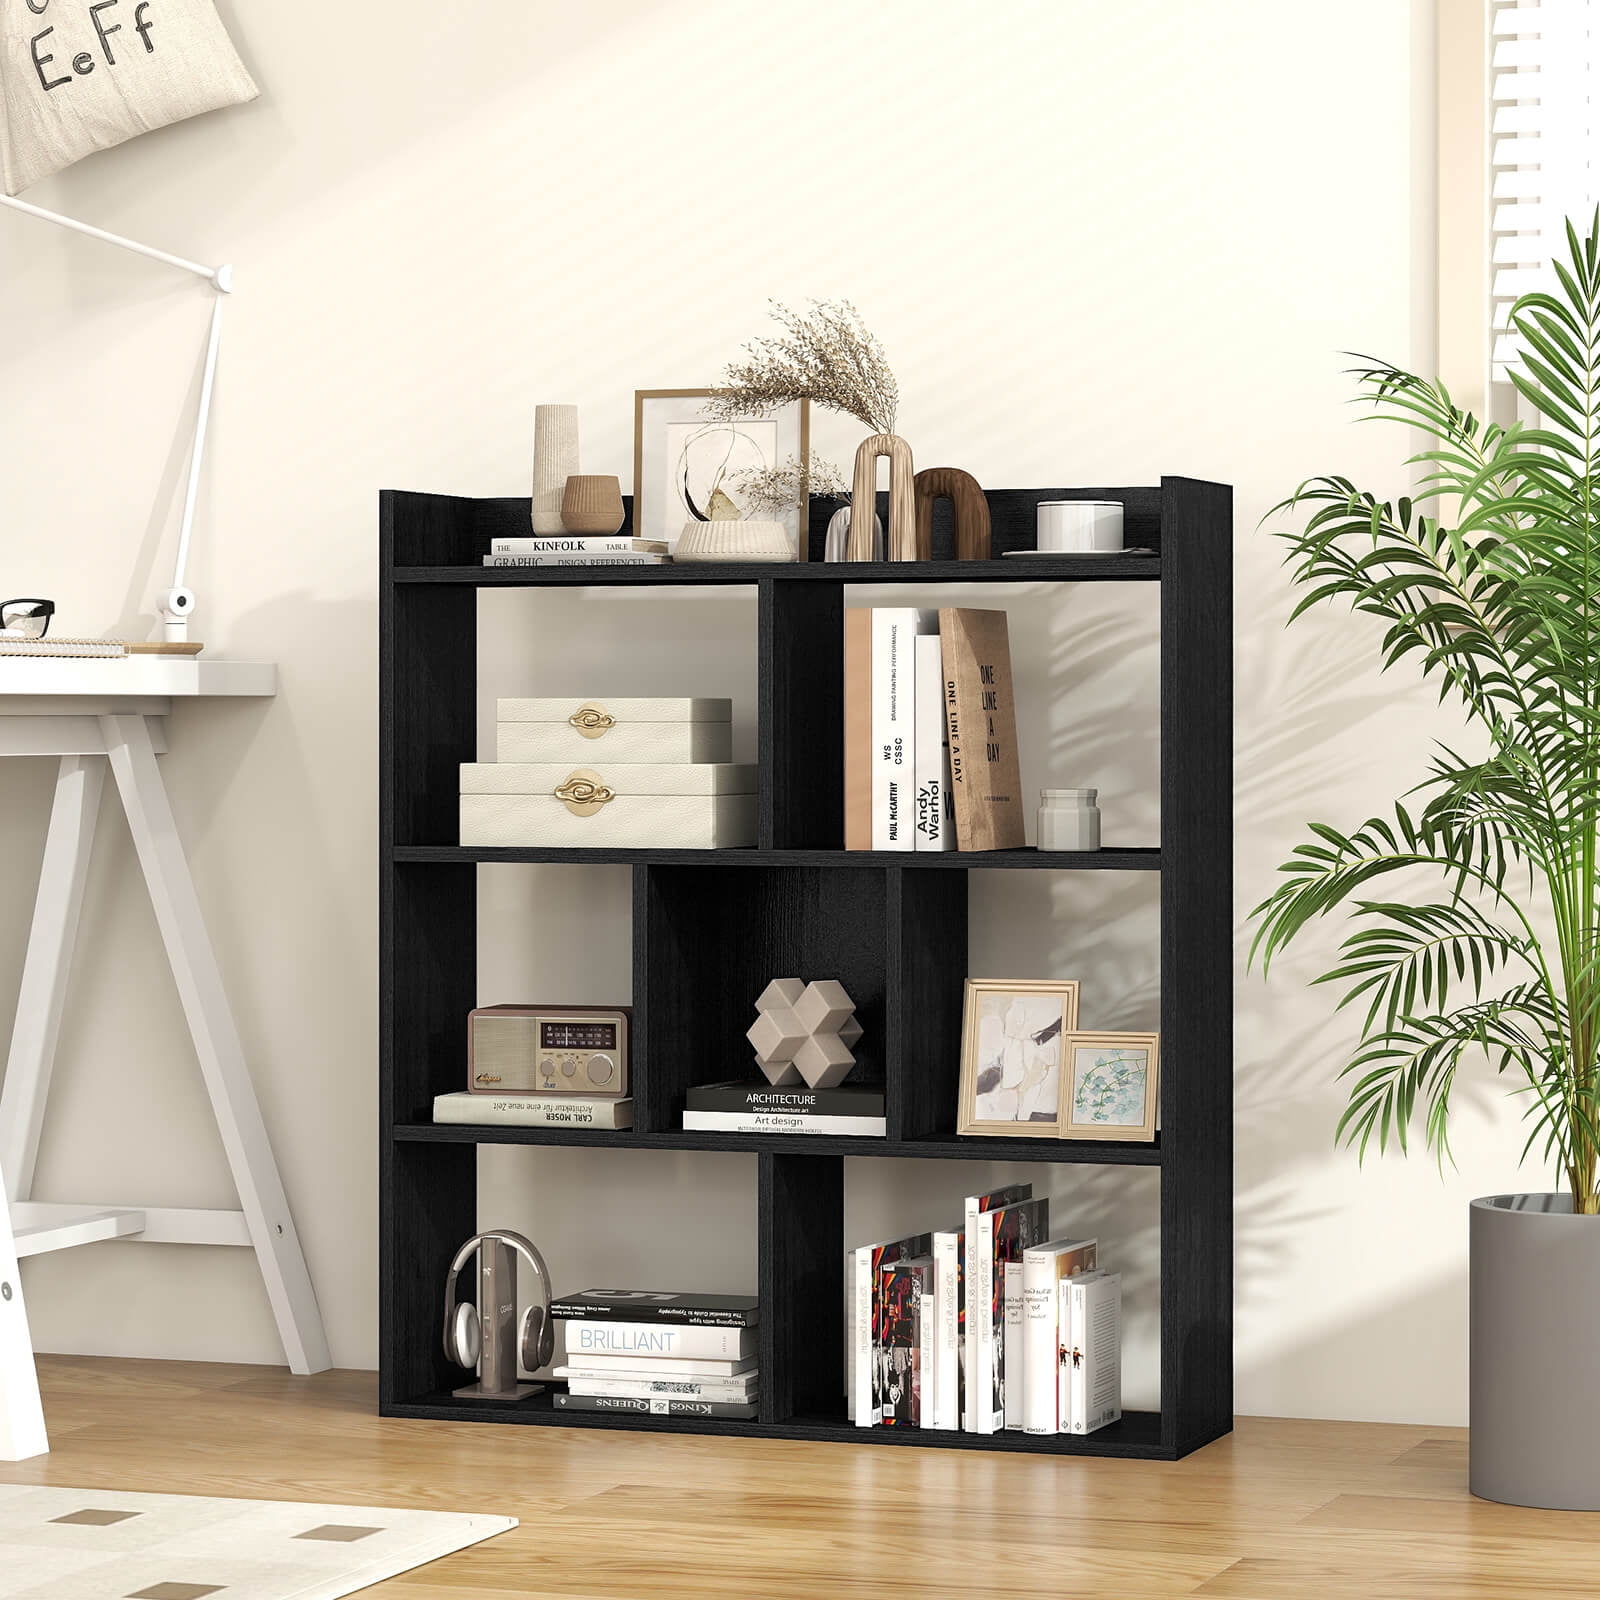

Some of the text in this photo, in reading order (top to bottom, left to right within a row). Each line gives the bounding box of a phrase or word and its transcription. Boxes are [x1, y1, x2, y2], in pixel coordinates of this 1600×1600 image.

[533, 541, 585, 551] KINFOLK
[606, 543, 628, 551] TABLE
[494, 557, 544, 567] GRAPHIC
[980, 665, 994, 685] ONE
[947, 681, 957, 706] ONE
[981, 691, 998, 711] LINE
[950, 713, 960, 741] LINE
[989, 717, 995, 737] A
[884, 745, 891, 760] WS
[894, 737, 903, 765] CSSC
[986, 743, 1000, 763] DAY
[954, 758, 963, 783] DAY
[889, 782, 898, 841] PAUL McCARTHY
[917, 787, 930, 833] Andy
[928, 780, 939, 841] Warhol
[493, 1102, 507, 1111] Zeit
[554, 1104, 593, 1114] Architektur
[746, 1093, 816, 1105] ARCHITECTURE
[546, 1113, 593, 1122] CARL MOSER
[755, 1116, 803, 1127] Art design
[580, 1329, 675, 1352] BRILLIANT
[596, 1399, 649, 1411] QUEENS
[670, 1403, 713, 1415] KINGS
